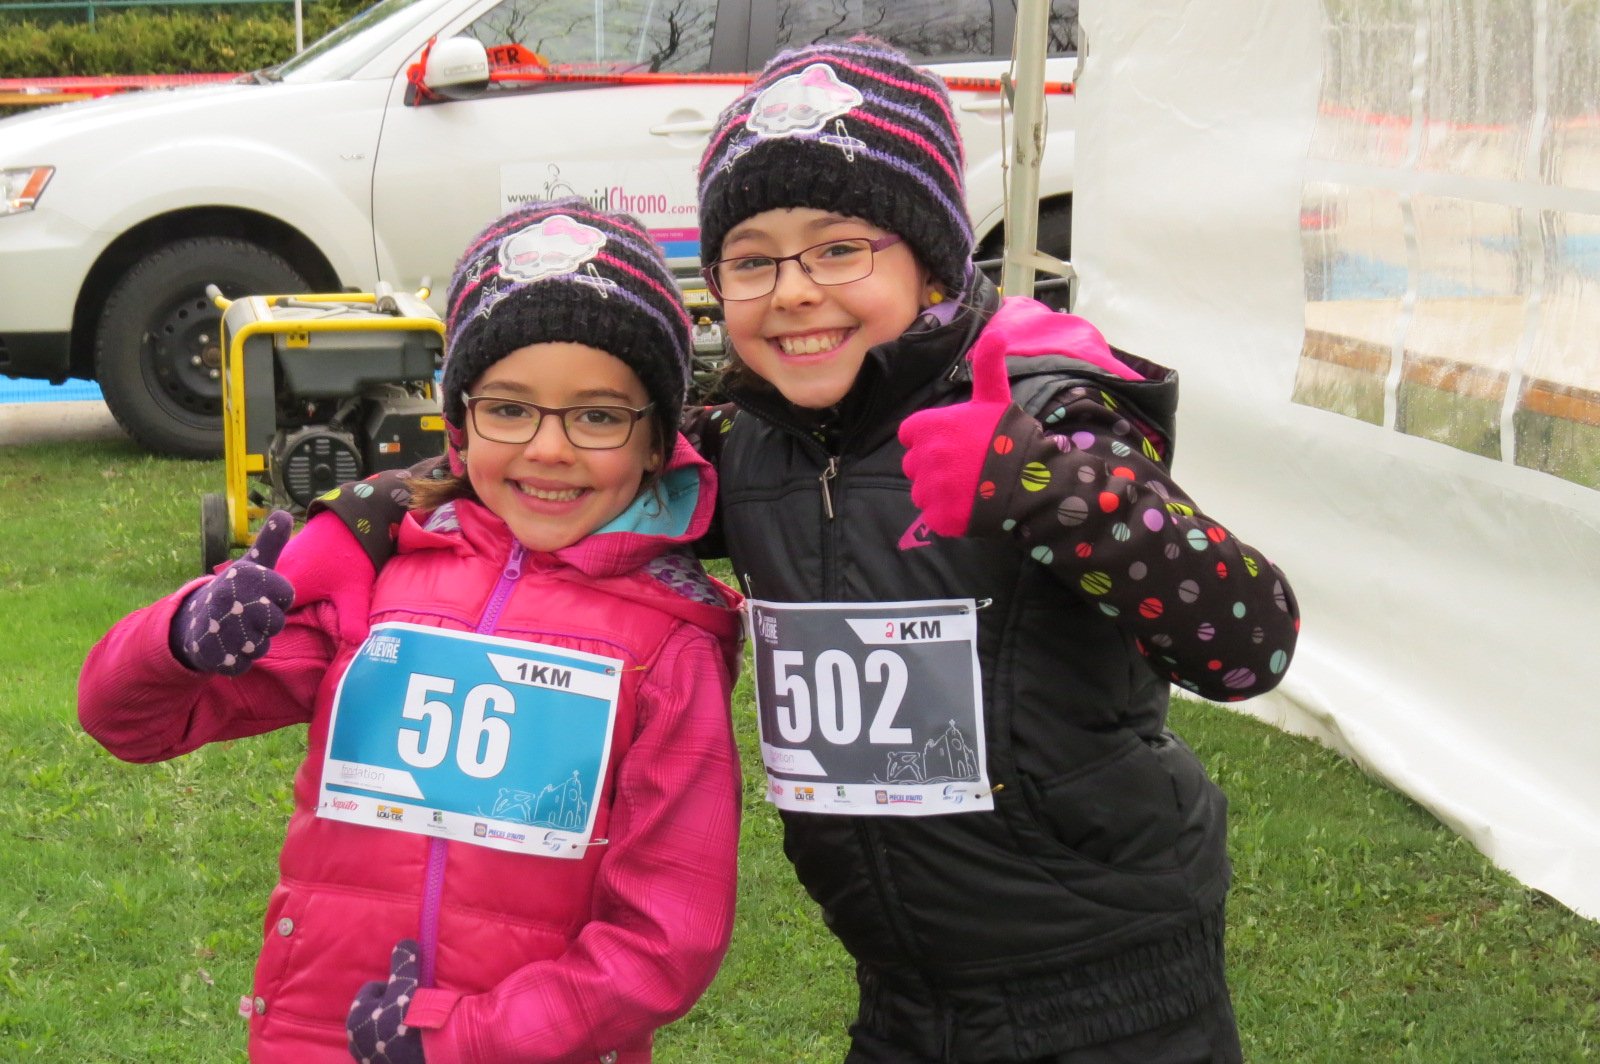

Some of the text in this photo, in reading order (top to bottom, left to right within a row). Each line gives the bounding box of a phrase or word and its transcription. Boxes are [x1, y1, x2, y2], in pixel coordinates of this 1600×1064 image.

[517, 662, 572, 688] 1KM
[773, 649, 912, 744] 502
[397, 673, 516, 778] 56
